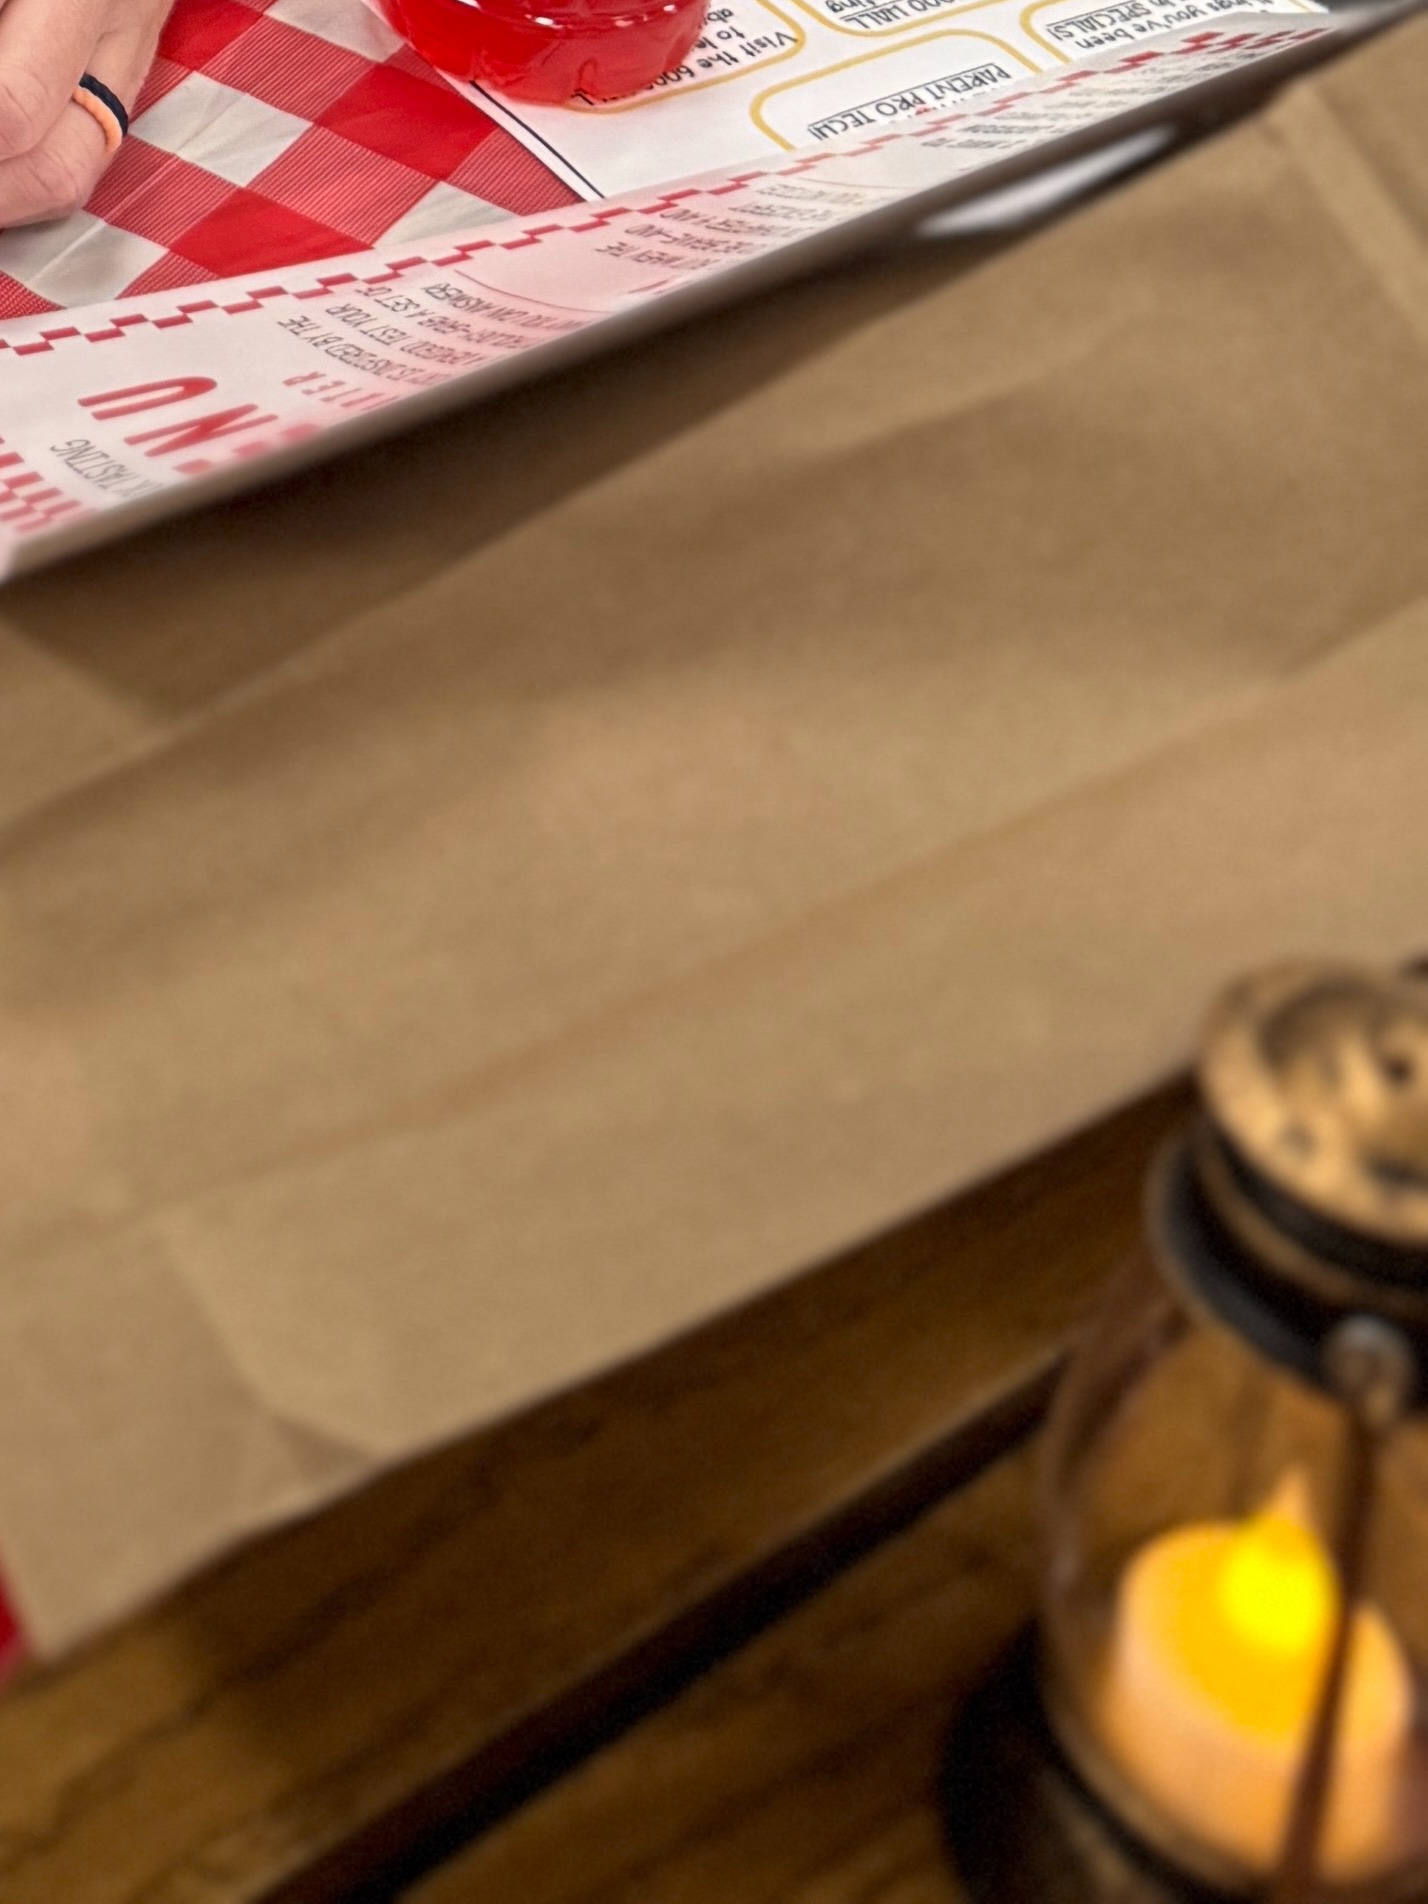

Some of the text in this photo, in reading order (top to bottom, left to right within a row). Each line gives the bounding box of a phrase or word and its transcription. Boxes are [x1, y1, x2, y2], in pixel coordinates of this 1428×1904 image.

[1044, 0, 1151, 42] SPECIALS!
[1134, 4, 1204, 32] you've
[738, 31, 797, 56] Visit
[1073, 27, 1133, 50] been
[696, 50, 738, 69] the
[806, 63, 1011, 140] PARENT PRO TECH!
